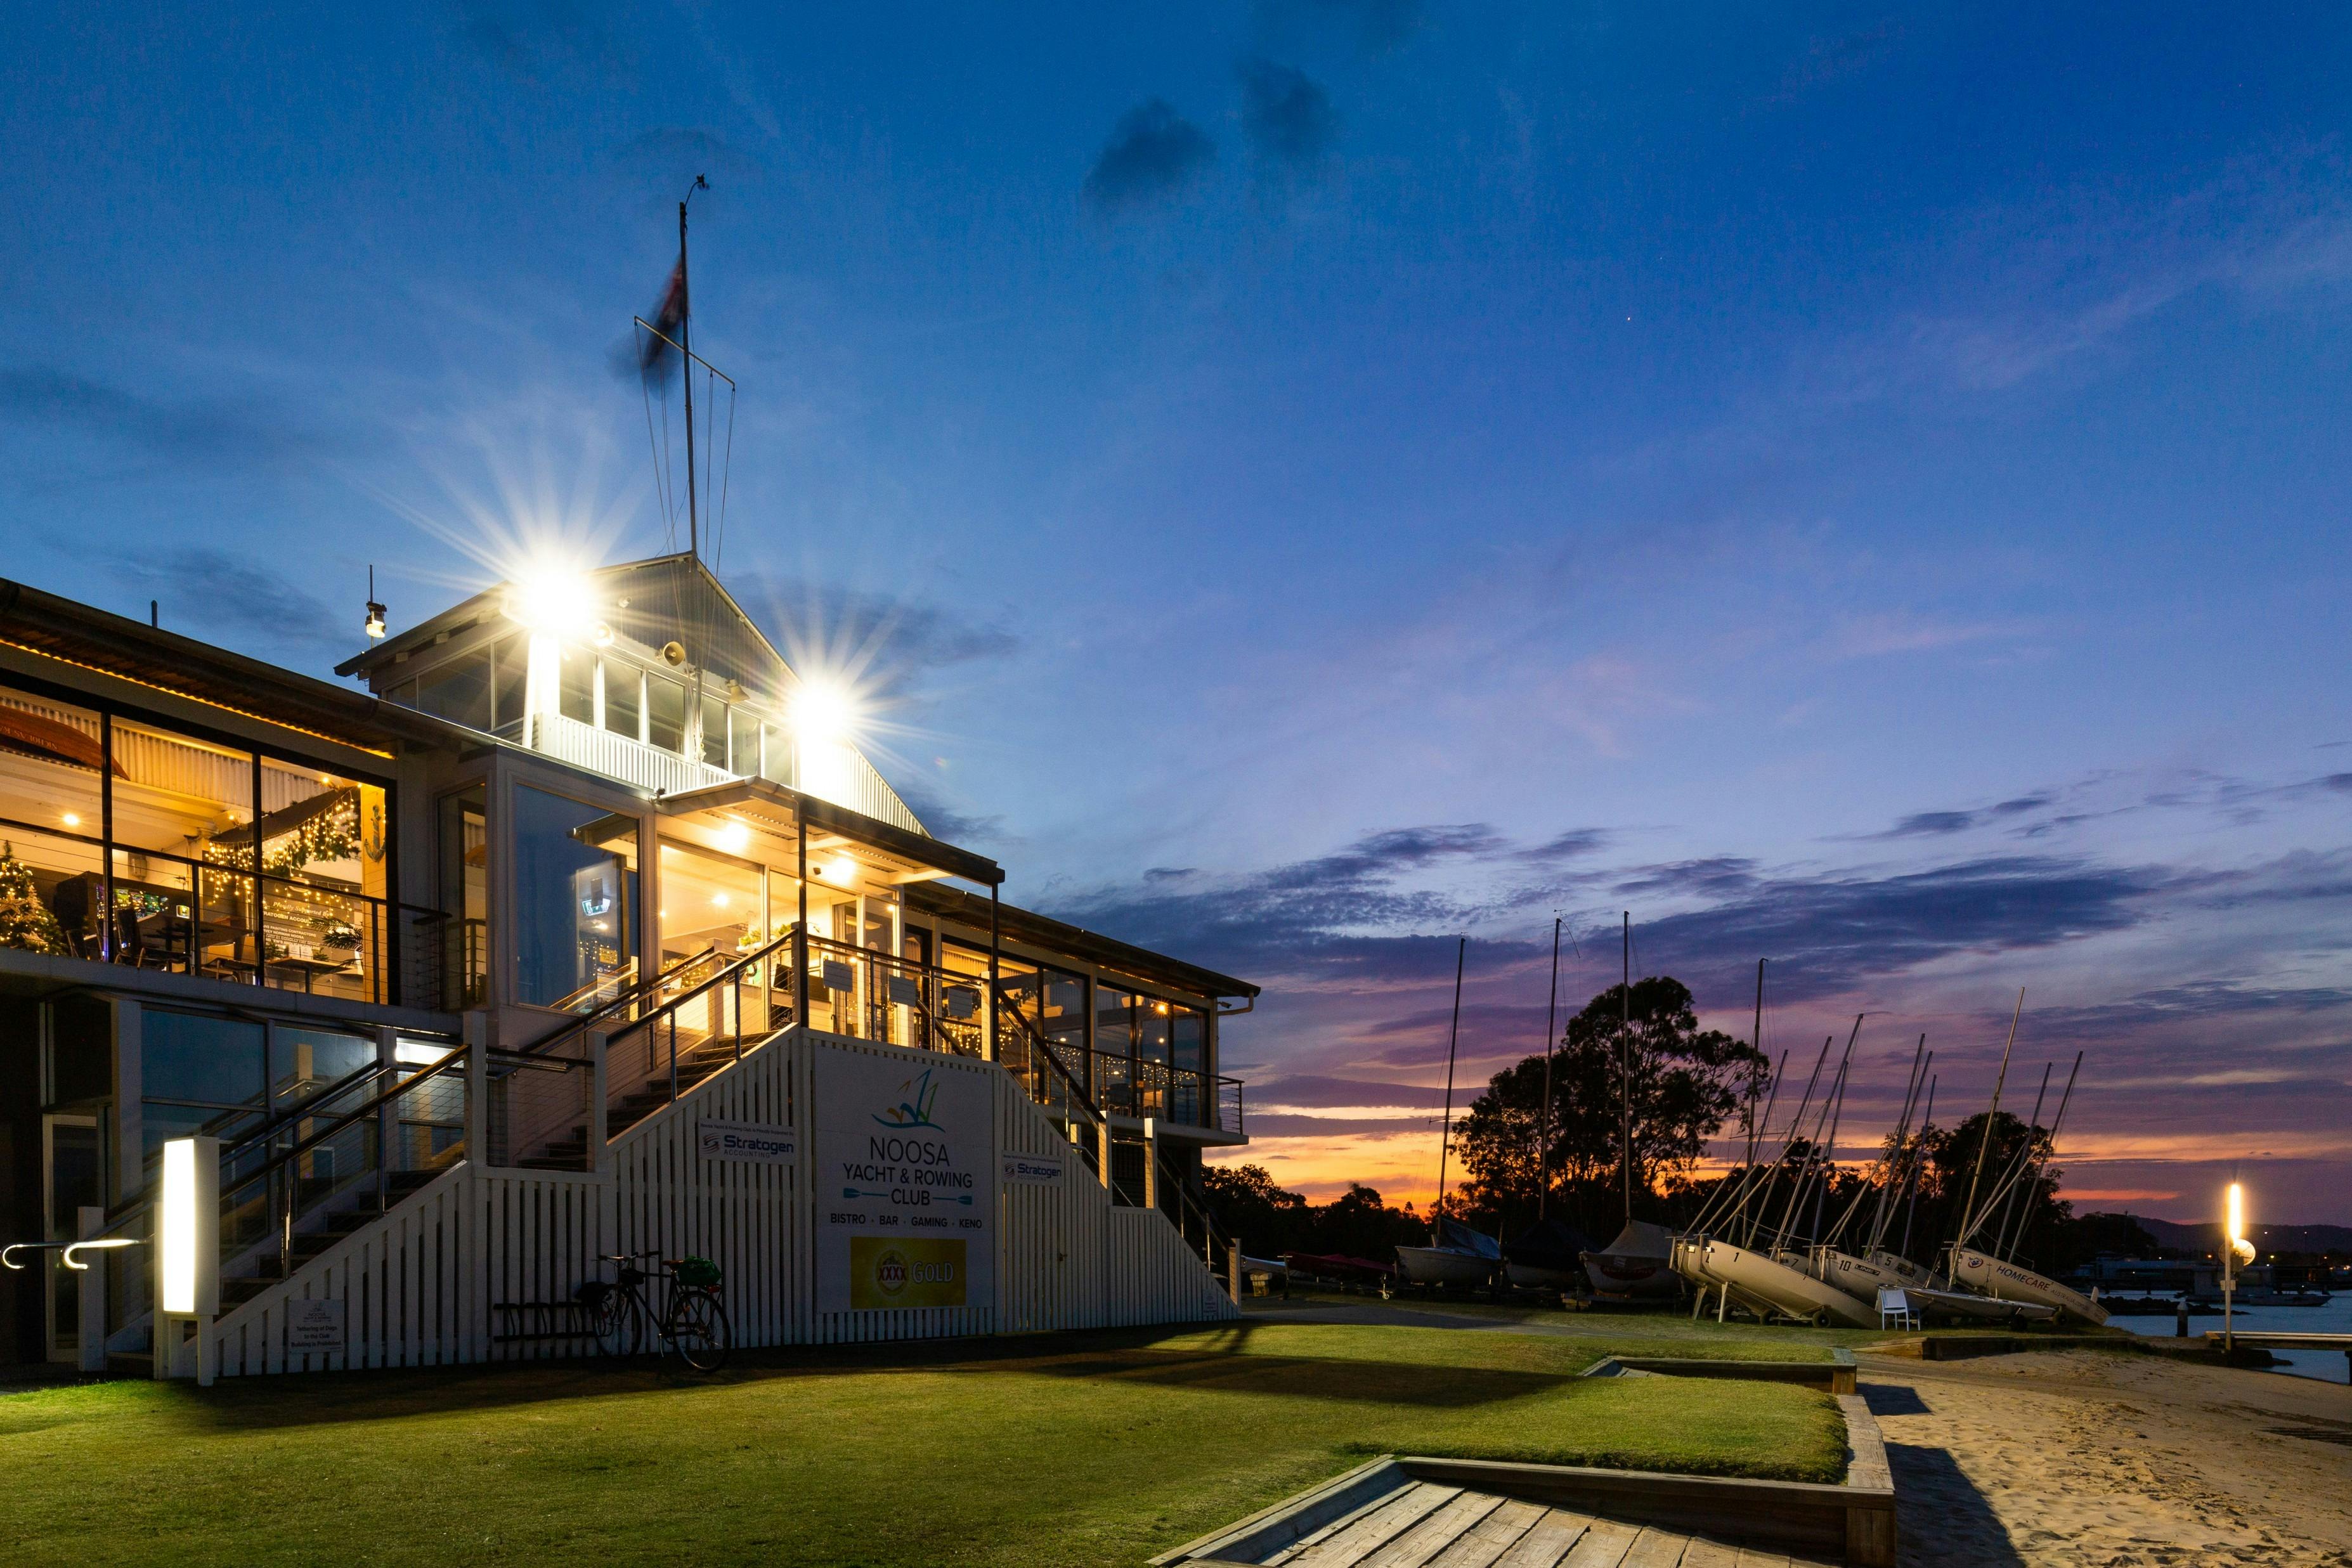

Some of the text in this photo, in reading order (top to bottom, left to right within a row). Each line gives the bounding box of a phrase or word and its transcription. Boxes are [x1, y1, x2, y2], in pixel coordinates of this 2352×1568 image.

[273, 902, 294, 910] Proudly
[263, 911, 289, 919] RATOGEN
[724, 1134, 794, 1155] Stratogen
[870, 1136, 950, 1167] NOOSA
[724, 1149, 770, 1158] ACCOUNTING
[843, 1162, 972, 1188] YACHT & ROWING
[1018, 1163, 1062, 1179] Stratogen
[891, 1188, 930, 1205] CLUB
[831, 1213, 982, 1229] BISTRO BAR GAMING KENO
[1734, 1252, 1739, 1262] 1
[1791, 1258, 1798, 1267] 7
[1885, 1257, 1892, 1266] 5
[878, 1260, 954, 1284] XXXX GOLD
[1839, 1260, 1851, 1271] 10
[1996, 1266, 2050, 1292] HOMECARE
